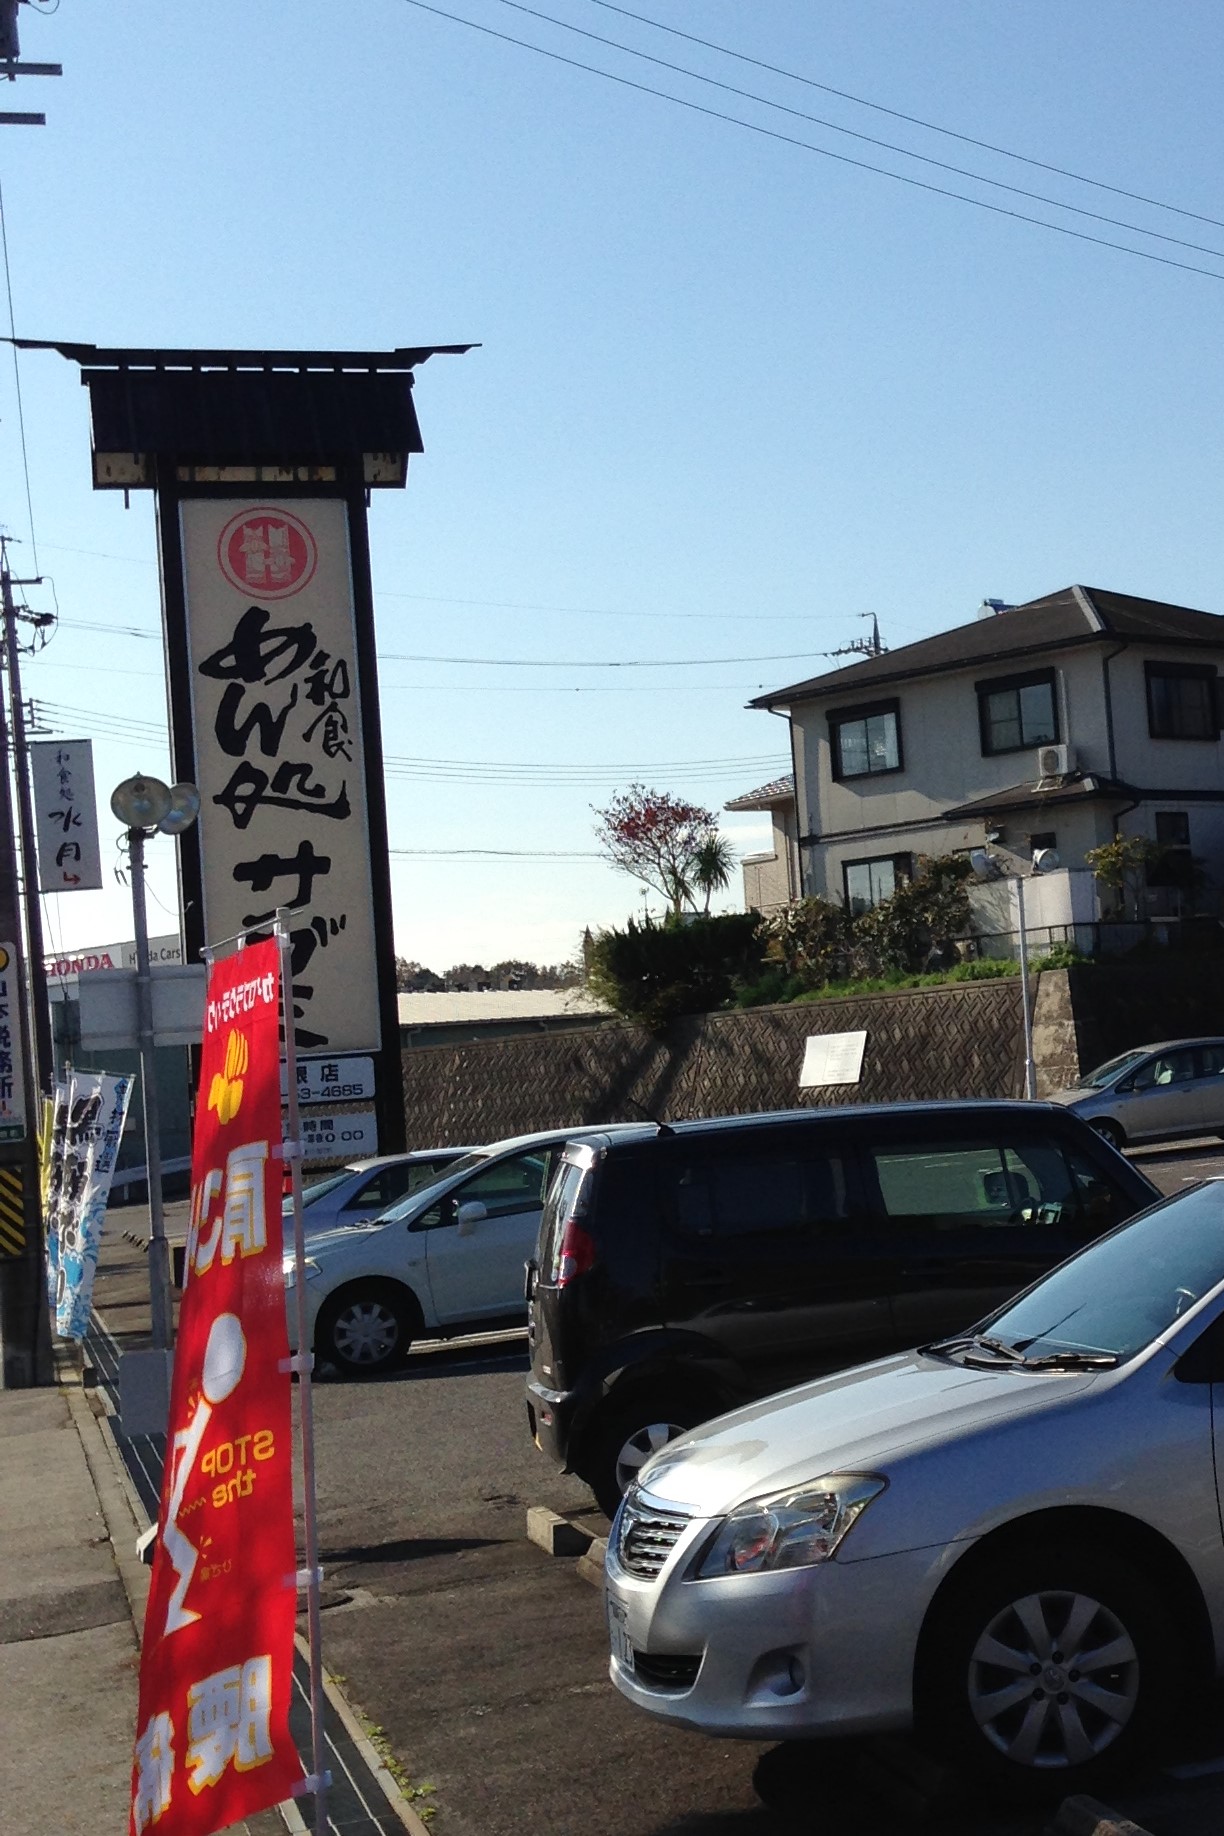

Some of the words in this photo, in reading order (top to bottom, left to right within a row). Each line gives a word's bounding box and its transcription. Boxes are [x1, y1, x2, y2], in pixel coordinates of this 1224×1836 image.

[303, 647, 352, 762] 和食
[48, 806, 82, 867] 水月
[160, 948, 181, 959] Cars
[297, 1083, 364, 1100] 3-4685
